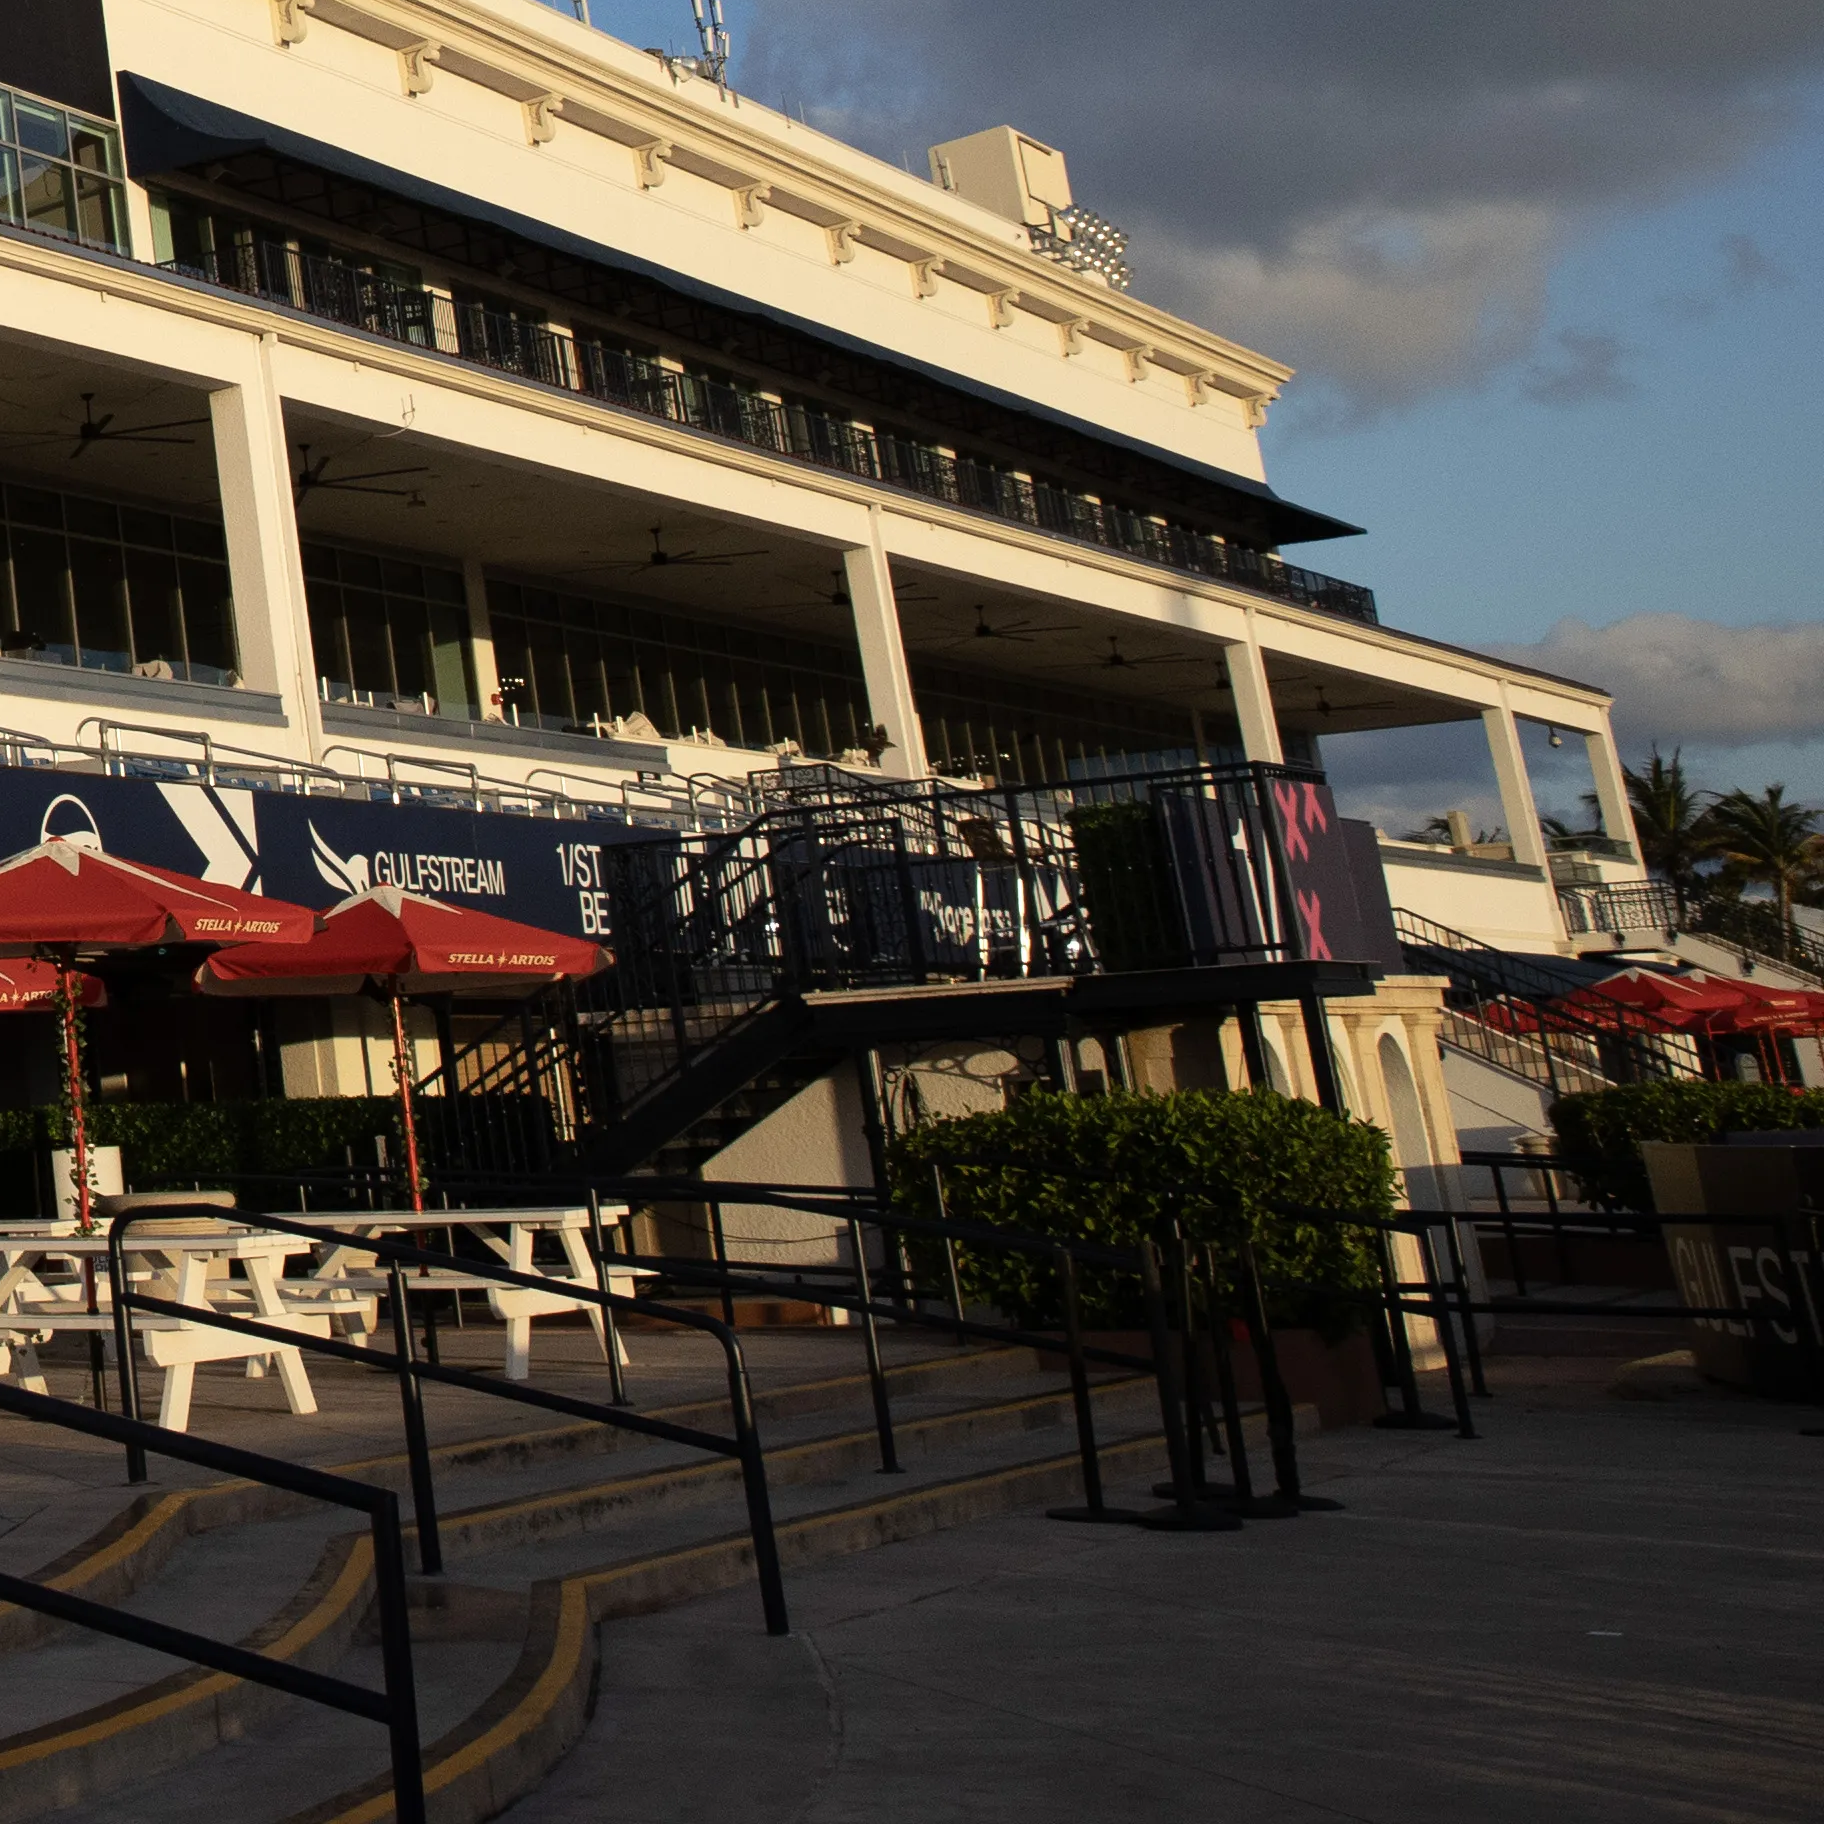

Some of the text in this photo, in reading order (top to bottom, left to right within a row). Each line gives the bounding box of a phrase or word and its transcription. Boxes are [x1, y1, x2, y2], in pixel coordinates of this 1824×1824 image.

[374, 850, 506, 896] GULFSTREAM
[556, 842, 601, 889] 1/ST
[194, 918, 281, 934] STELLA ARTOIS
[579, 890, 611, 935] BE
[447, 953, 556, 966] STELLA ARTOIS
[21, 989, 57, 1003] ARTO
